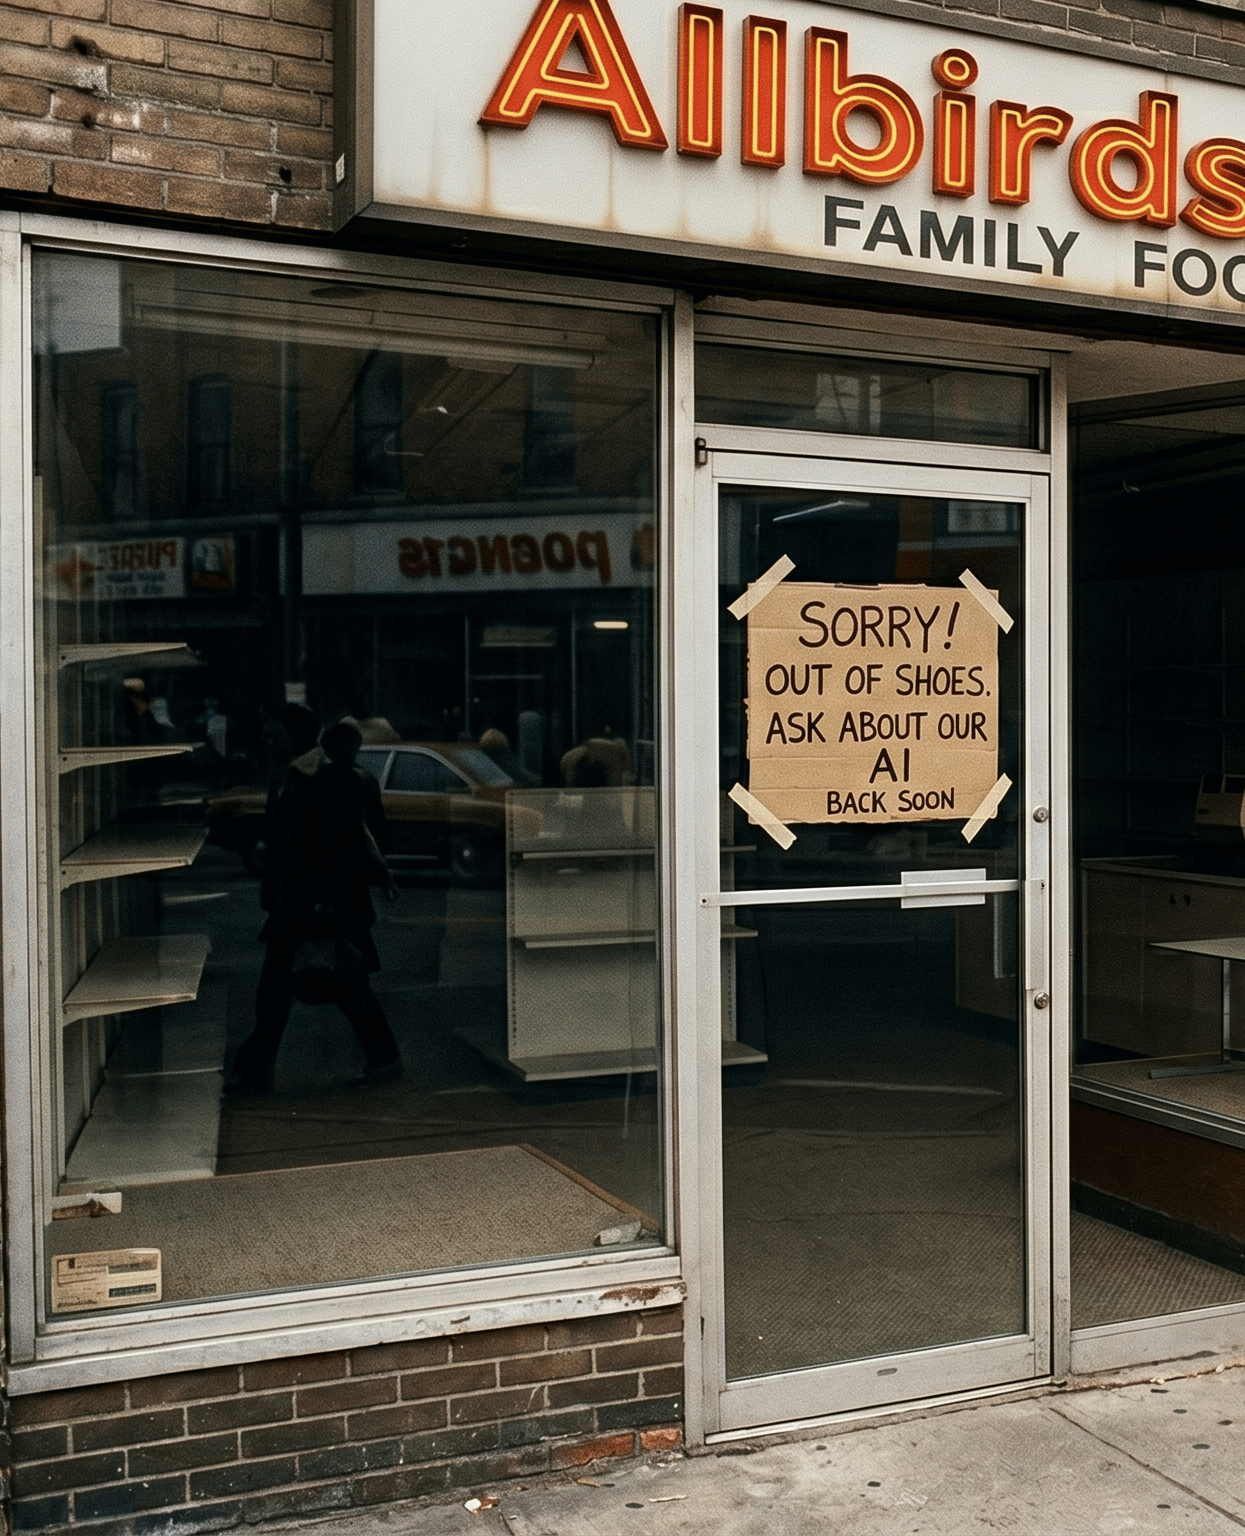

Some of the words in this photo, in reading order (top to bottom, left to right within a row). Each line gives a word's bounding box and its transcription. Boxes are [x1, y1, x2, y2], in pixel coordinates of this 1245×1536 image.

[824, 195, 1080, 278] FAMILY
[798, 601, 960, 653] SORRY!
[765, 664, 832, 696] OUT
[845, 664, 883, 695] OF
[896, 664, 992, 697] SHOES.
[766, 711, 826, 745] ASK
[838, 711, 928, 743] ABOUT
[938, 711, 988, 742] OUR
[869, 748, 910, 784] AI
[827, 791, 887, 815] BACK
[898, 787, 955, 812] SOON
